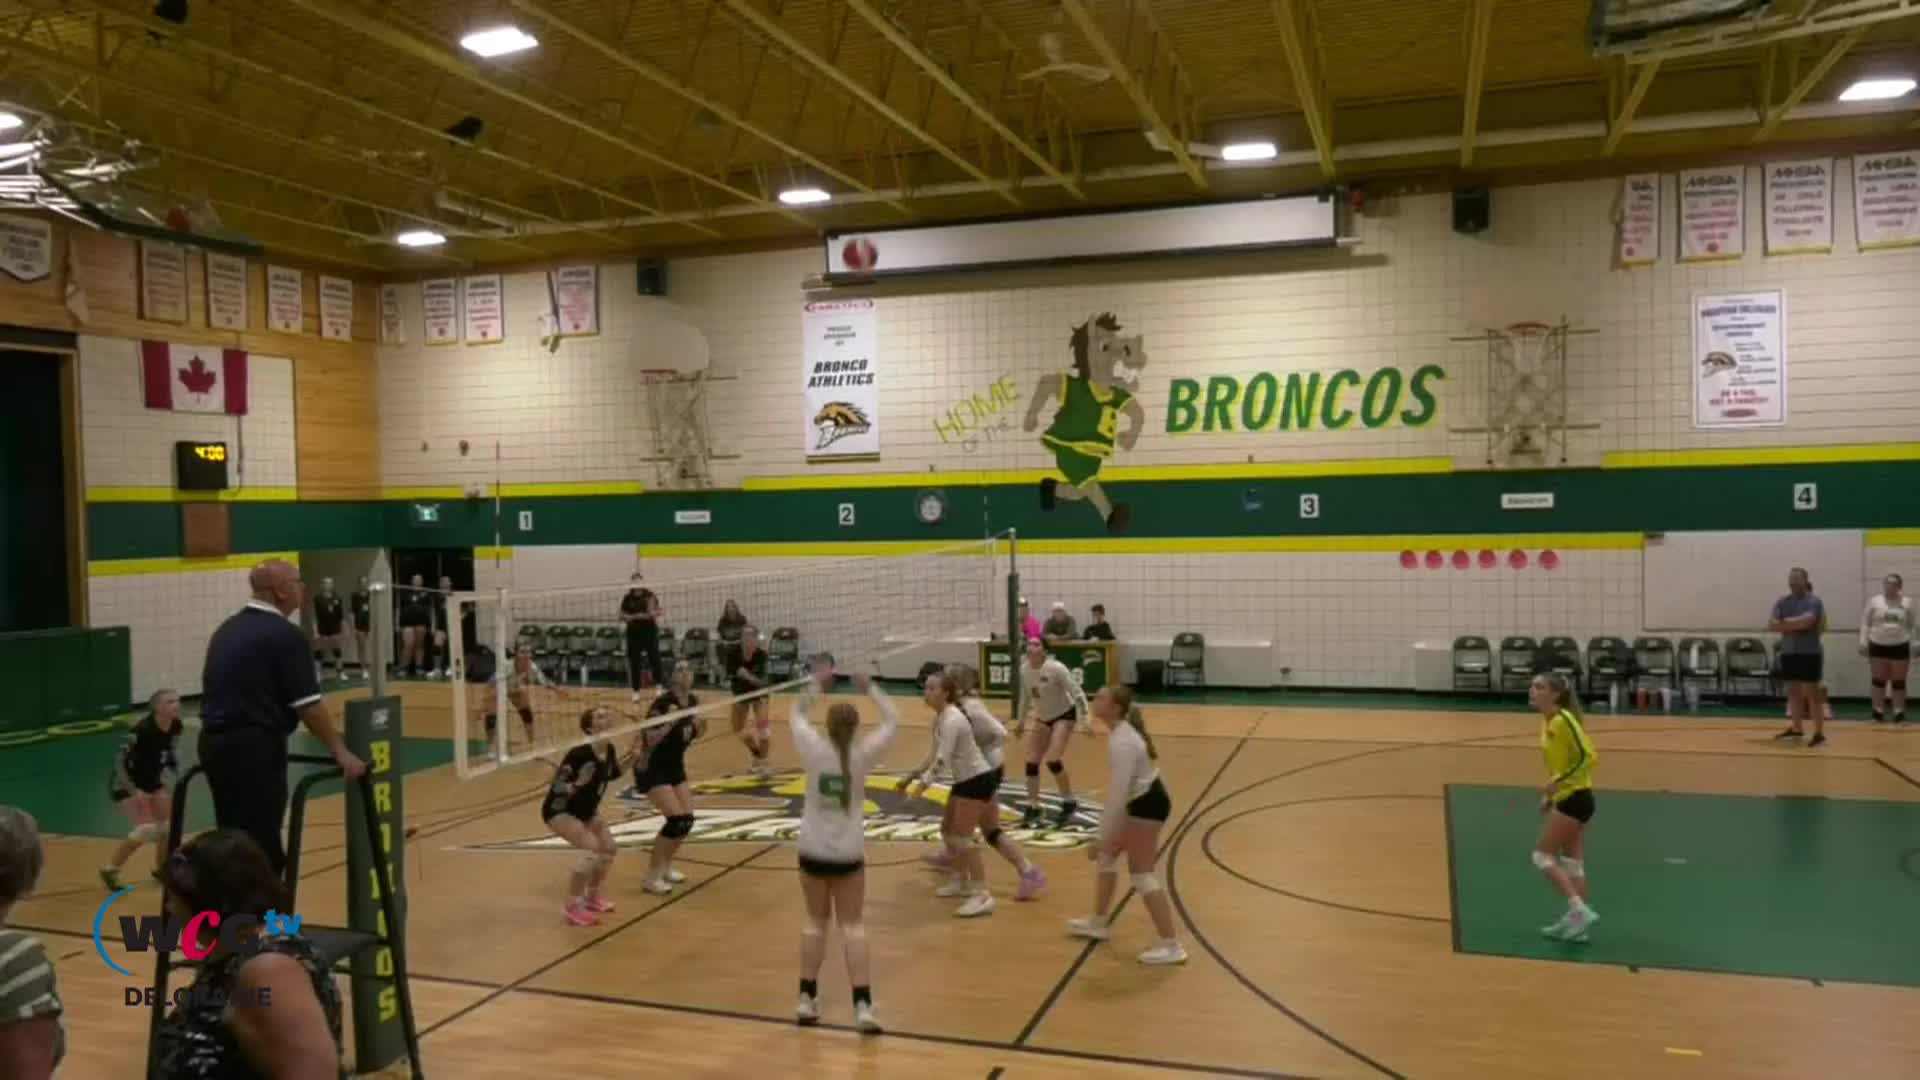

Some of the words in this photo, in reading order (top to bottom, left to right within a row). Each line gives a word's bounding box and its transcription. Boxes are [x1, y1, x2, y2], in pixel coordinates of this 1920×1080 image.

[813, 359, 869, 374] BRONCO
[807, 372, 875, 389] ATHLETICS
[1166, 364, 1446, 433] BRONCOS
[933, 374, 1023, 443] HOME
[1798, 486, 1812, 506] 4
[841, 507, 852, 522] 2
[1303, 497, 1316, 515] 3
